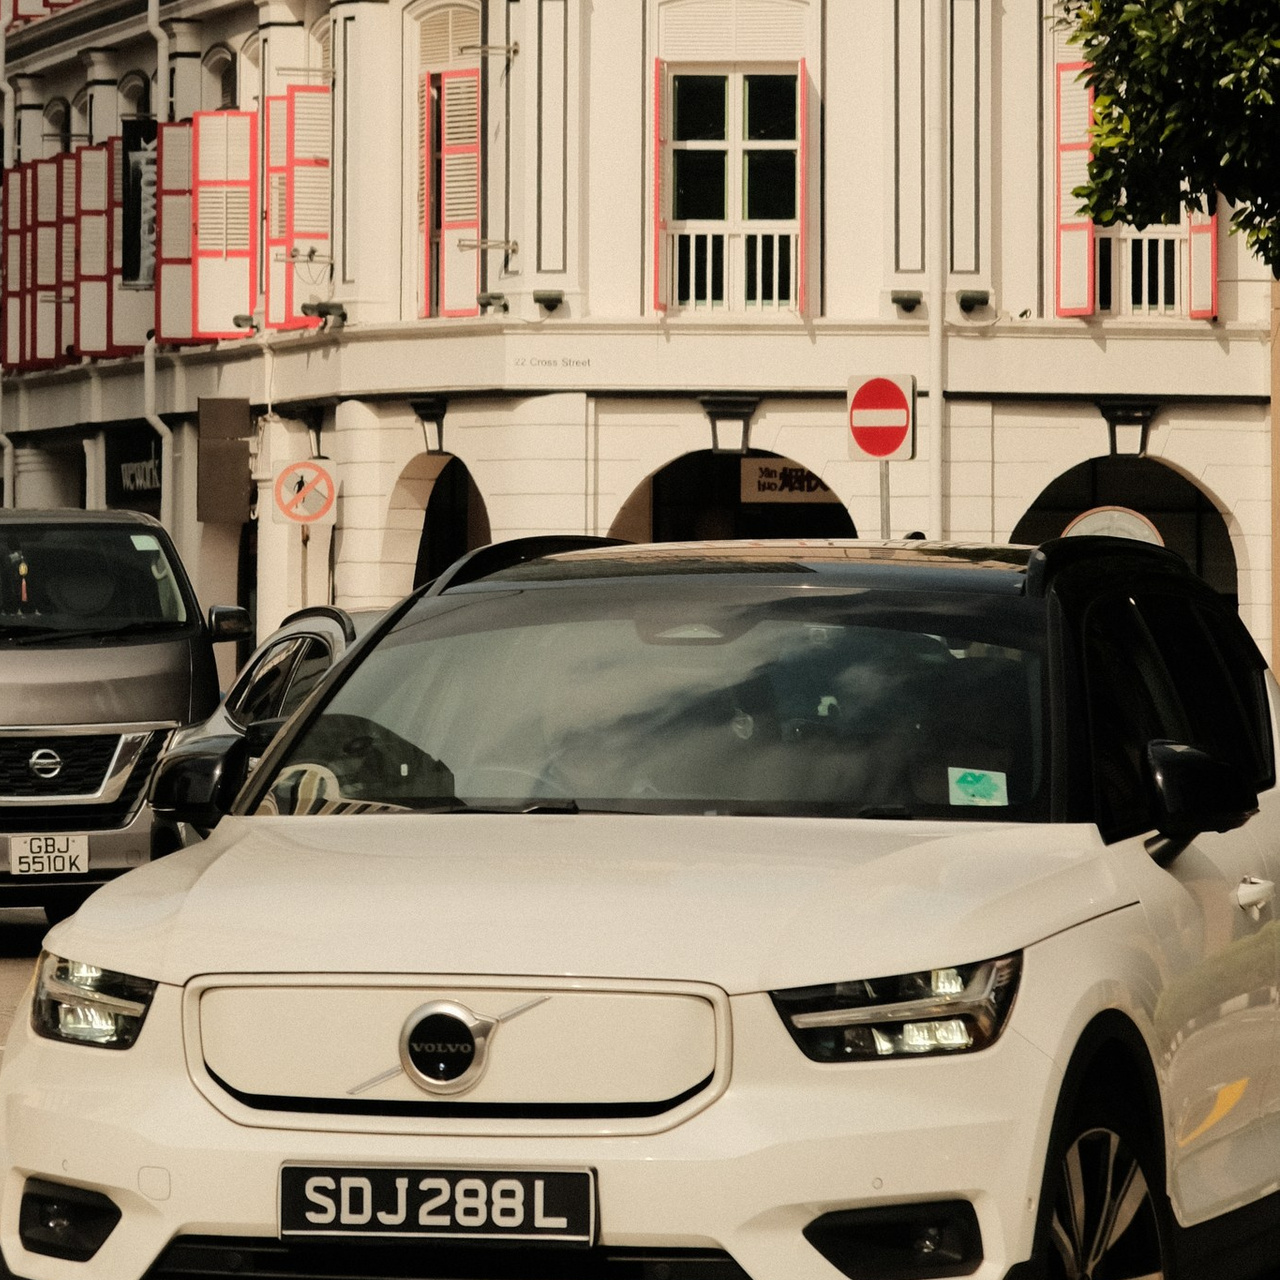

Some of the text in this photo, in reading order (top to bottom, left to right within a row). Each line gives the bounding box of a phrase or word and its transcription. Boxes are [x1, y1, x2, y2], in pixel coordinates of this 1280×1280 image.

[530, 358, 558, 367] Cross
[561, 358, 591, 367] Street
[29, 837, 69, 855] GBJ
[18, 855, 81, 873] 5510K
[412, 1042, 471, 1053] VOLVO
[305, 1176, 568, 1229] SDJ288L
